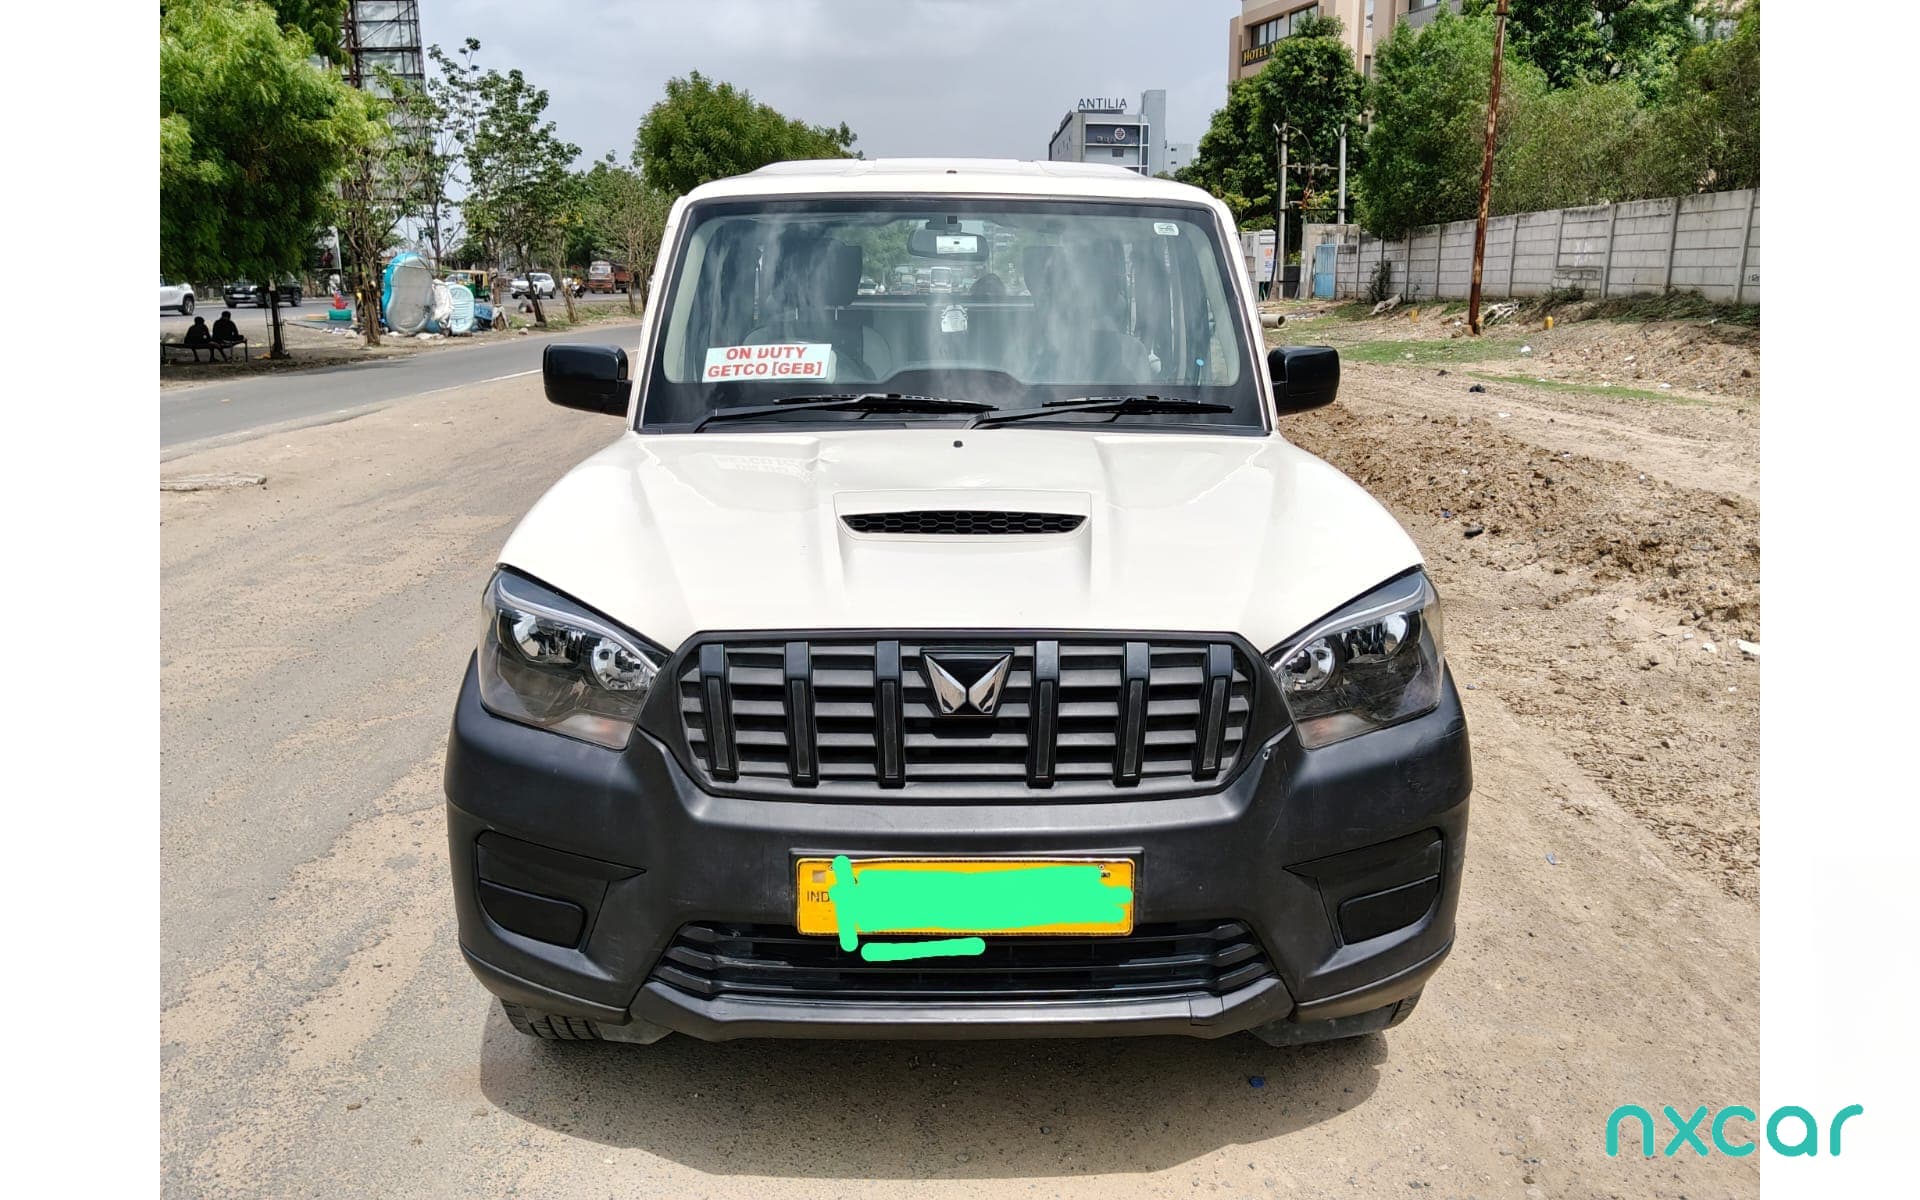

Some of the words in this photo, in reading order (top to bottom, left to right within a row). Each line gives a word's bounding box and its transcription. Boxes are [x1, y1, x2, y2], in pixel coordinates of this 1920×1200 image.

[1243, 46, 1268, 65] HOTEL
[1078, 98, 1128, 110] ANTILIA
[726, 347, 752, 361] ON
[757, 346, 808, 360] DUTY
[708, 363, 769, 378] GETCO
[771, 361, 823, 377] [GEB]
[806, 890, 830, 903] IND
